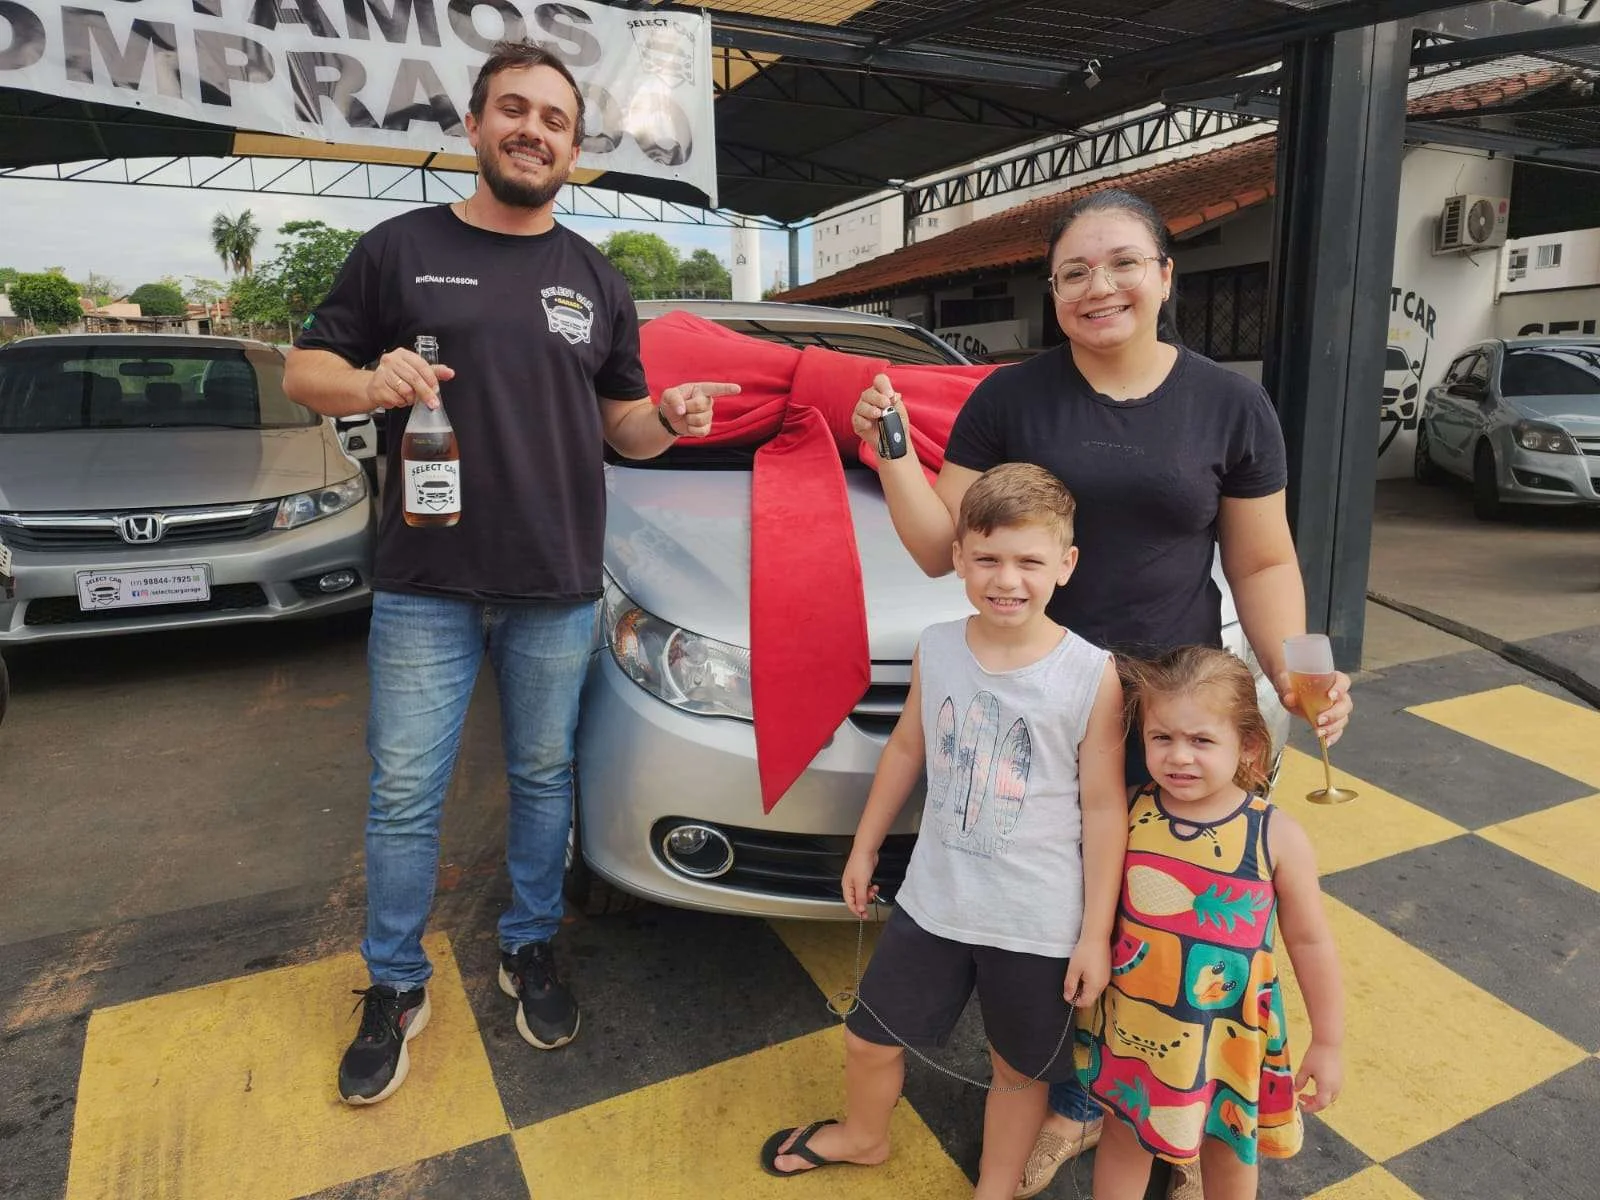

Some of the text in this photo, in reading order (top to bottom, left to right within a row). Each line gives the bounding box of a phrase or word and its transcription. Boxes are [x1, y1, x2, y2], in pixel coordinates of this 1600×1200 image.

[627, 18, 668, 29] SELECT
[415, 274, 445, 284] RHENAN
[1403, 291, 1437, 340] CAR
[411, 463, 442, 477] SELECT
